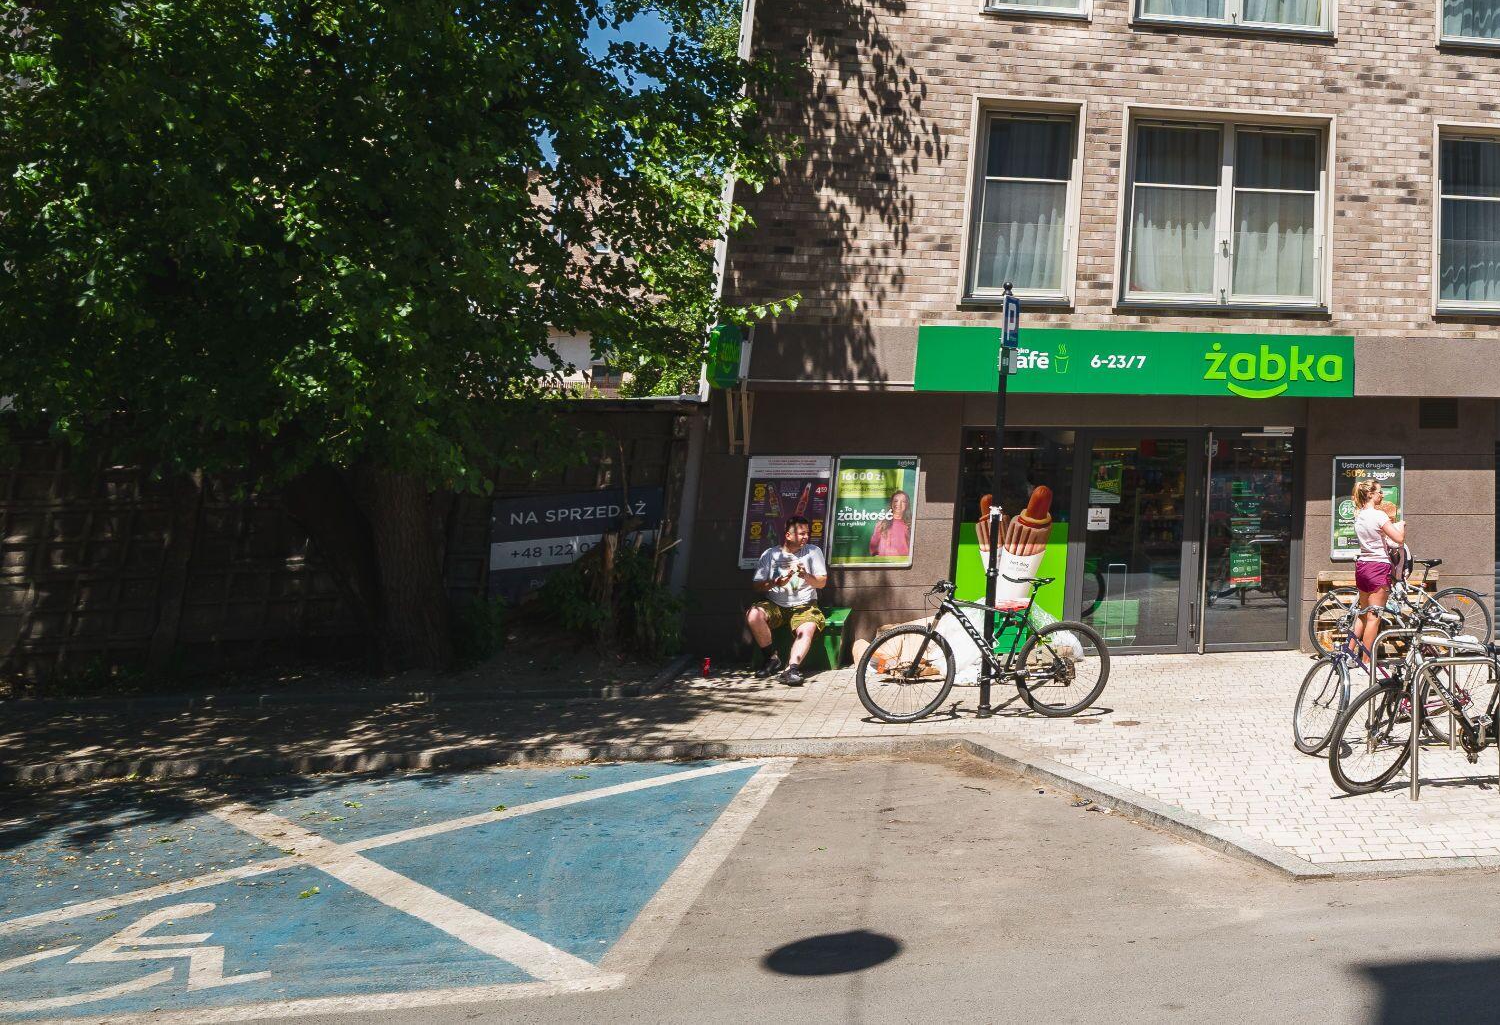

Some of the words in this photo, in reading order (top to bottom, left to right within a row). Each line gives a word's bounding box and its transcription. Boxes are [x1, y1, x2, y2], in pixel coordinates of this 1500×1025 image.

[1006, 303, 1017, 341] P
[1090, 354, 1147, 369] 6-23/7
[1203, 342, 1344, 383] żabka
[509, 511, 539, 526] NA
[837, 508, 894, 521] żabkość
[510, 546, 543, 559] +48
[549, 543, 575, 557] 122
